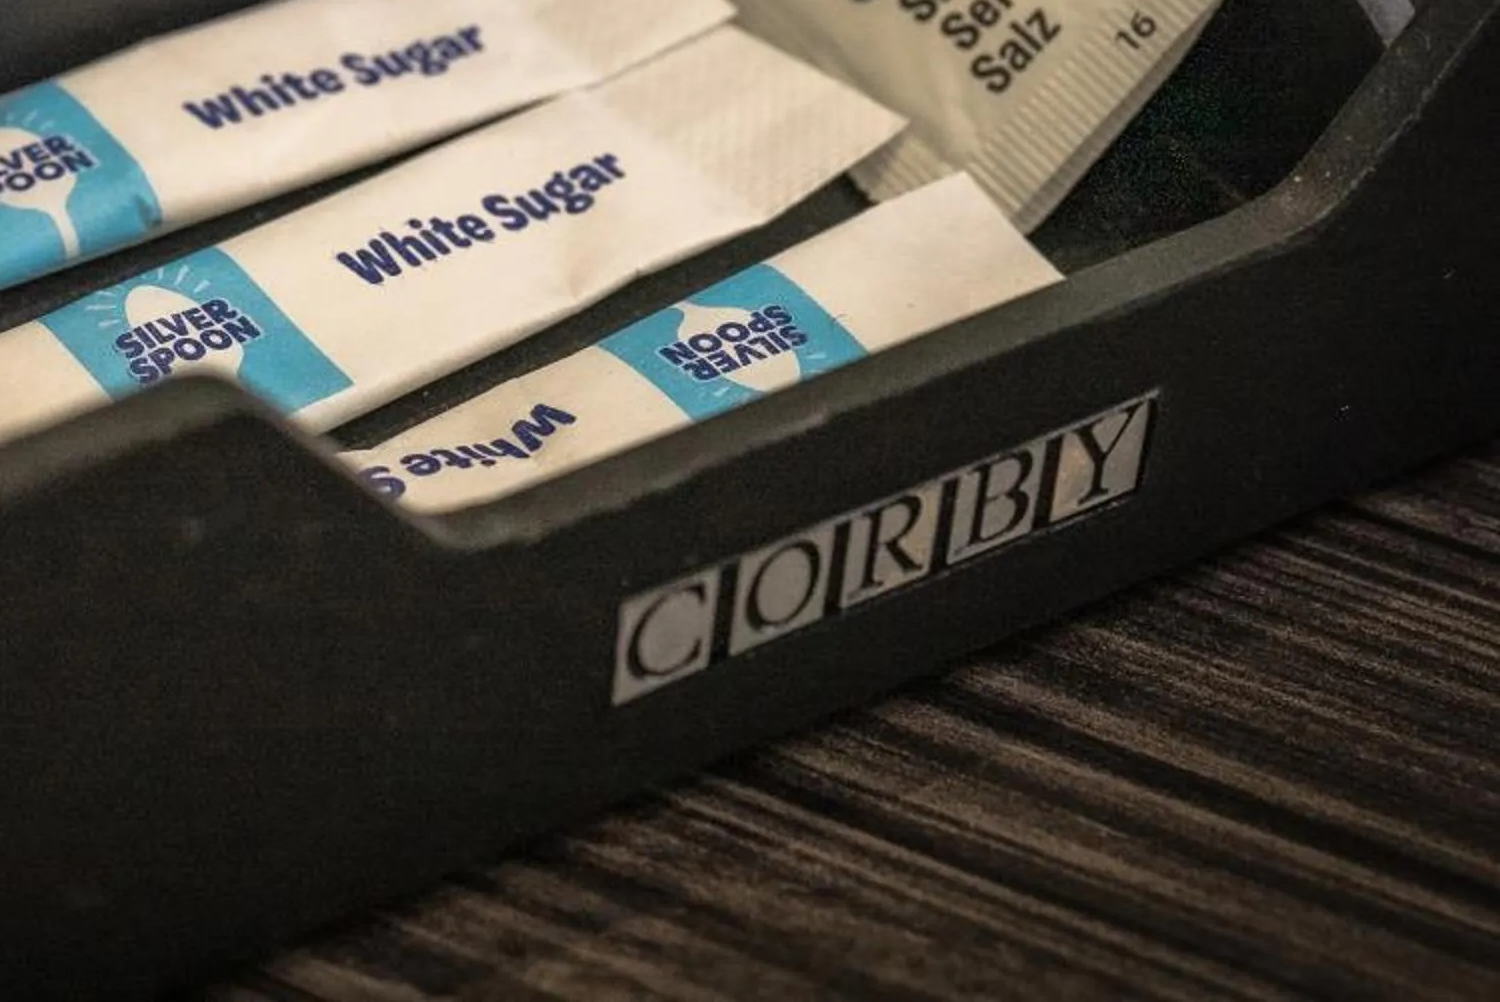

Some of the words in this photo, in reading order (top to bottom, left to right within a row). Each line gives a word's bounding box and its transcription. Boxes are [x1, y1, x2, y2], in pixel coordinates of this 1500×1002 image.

[970, 7, 1062, 94] Salz
[1114, 9, 1160, 50] 16
[182, 71, 346, 130] White
[339, 24, 486, 88] Sugar
[336, 217, 496, 285] White
[480, 152, 627, 232] Sugar
[114, 298, 238, 360] SILVER
[128, 314, 262, 385] SPOON
[658, 304, 794, 367] SPOON
[680, 324, 809, 382] SILVER
[399, 402, 578, 477] White
[627, 401, 1148, 680] CORBY
